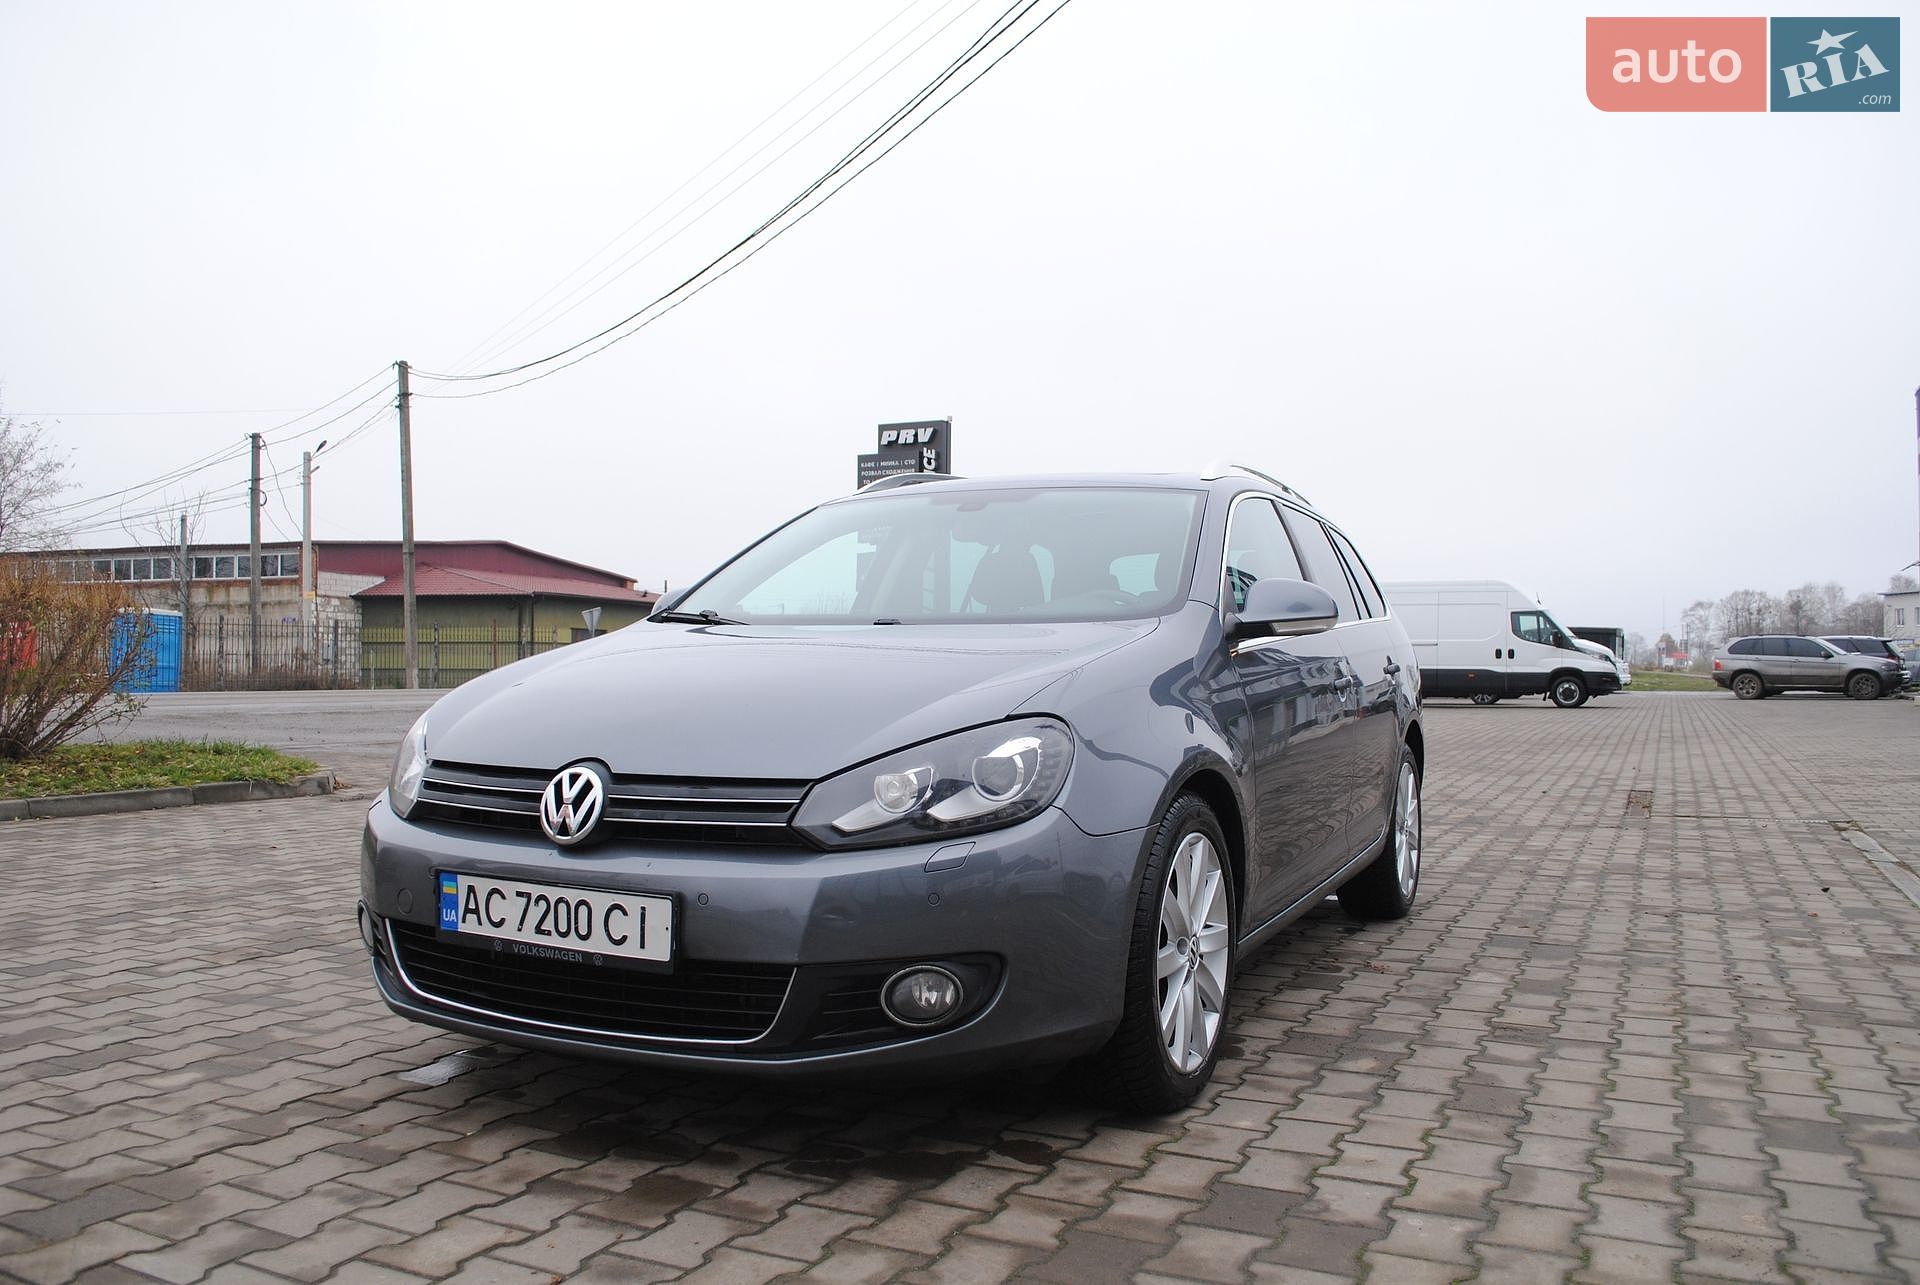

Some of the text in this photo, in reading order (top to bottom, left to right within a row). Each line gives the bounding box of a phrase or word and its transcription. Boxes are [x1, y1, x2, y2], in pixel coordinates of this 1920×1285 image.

[881, 427, 934, 445] PRV
[443, 908, 457, 922] UA
[461, 884, 647, 950] AC 7200 CI
[512, 943, 583, 963] VOLKSWAGEN
